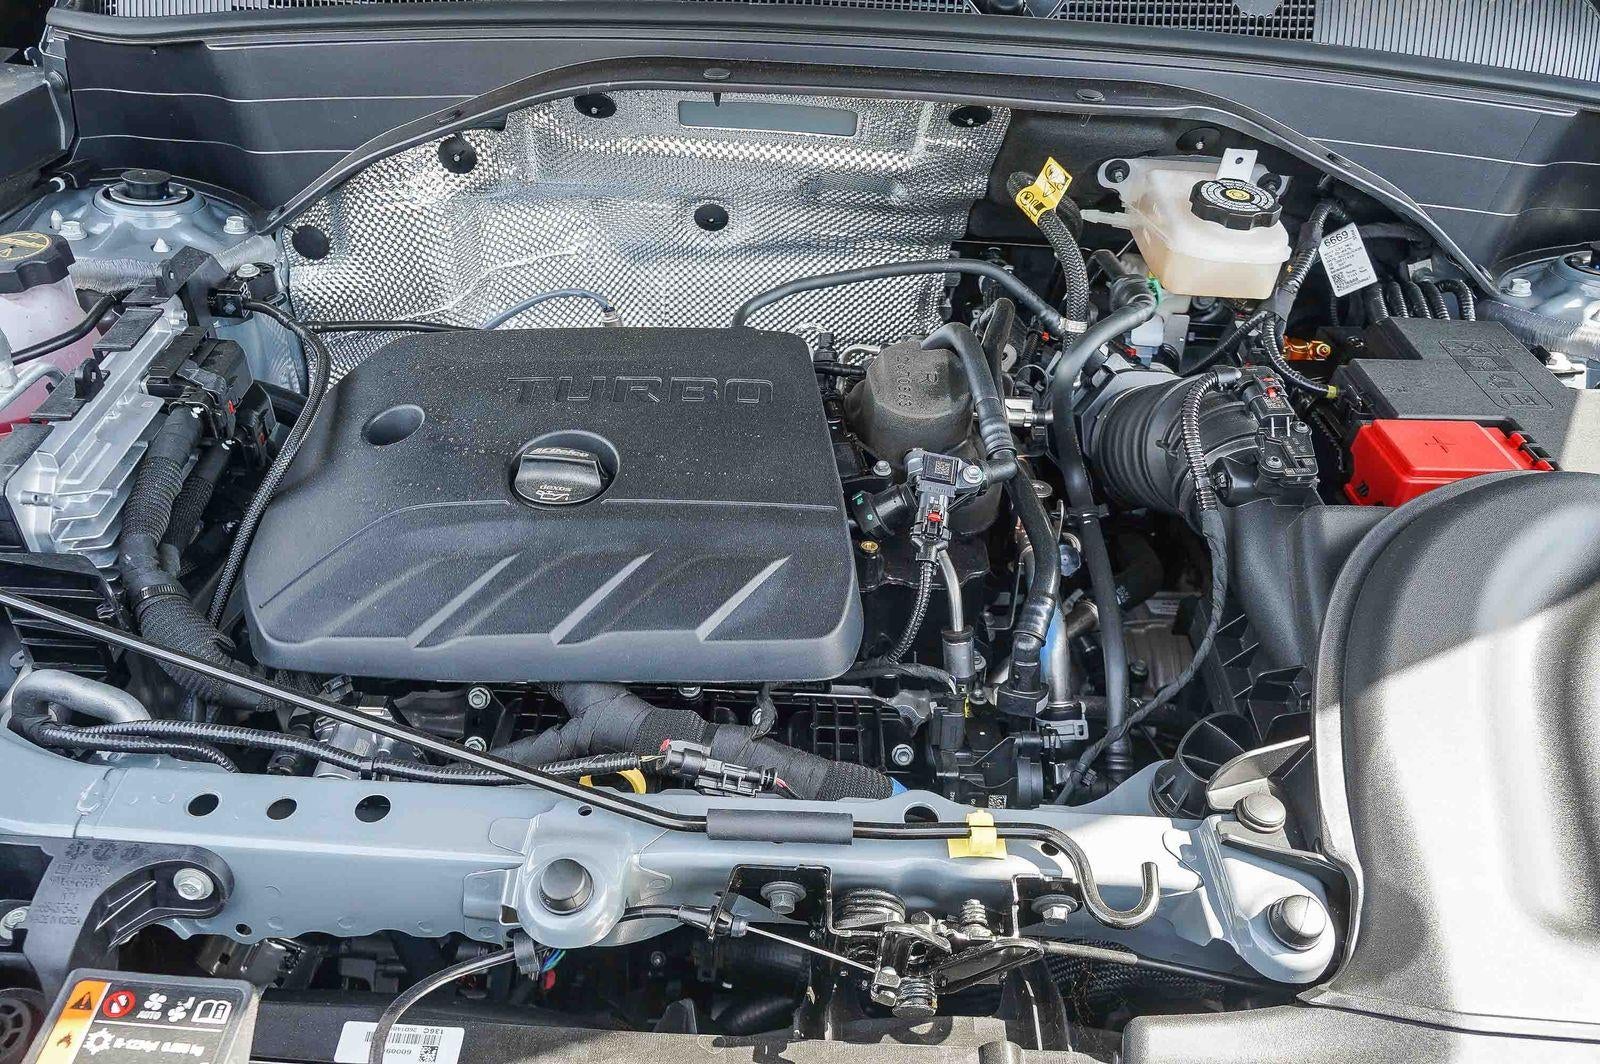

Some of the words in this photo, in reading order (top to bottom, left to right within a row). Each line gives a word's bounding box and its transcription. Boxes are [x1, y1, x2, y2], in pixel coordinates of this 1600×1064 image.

[1324, 230, 1349, 247] 6669
[507, 376, 774, 405] TURBO
[136, 1010, 162, 1020] AUTO
